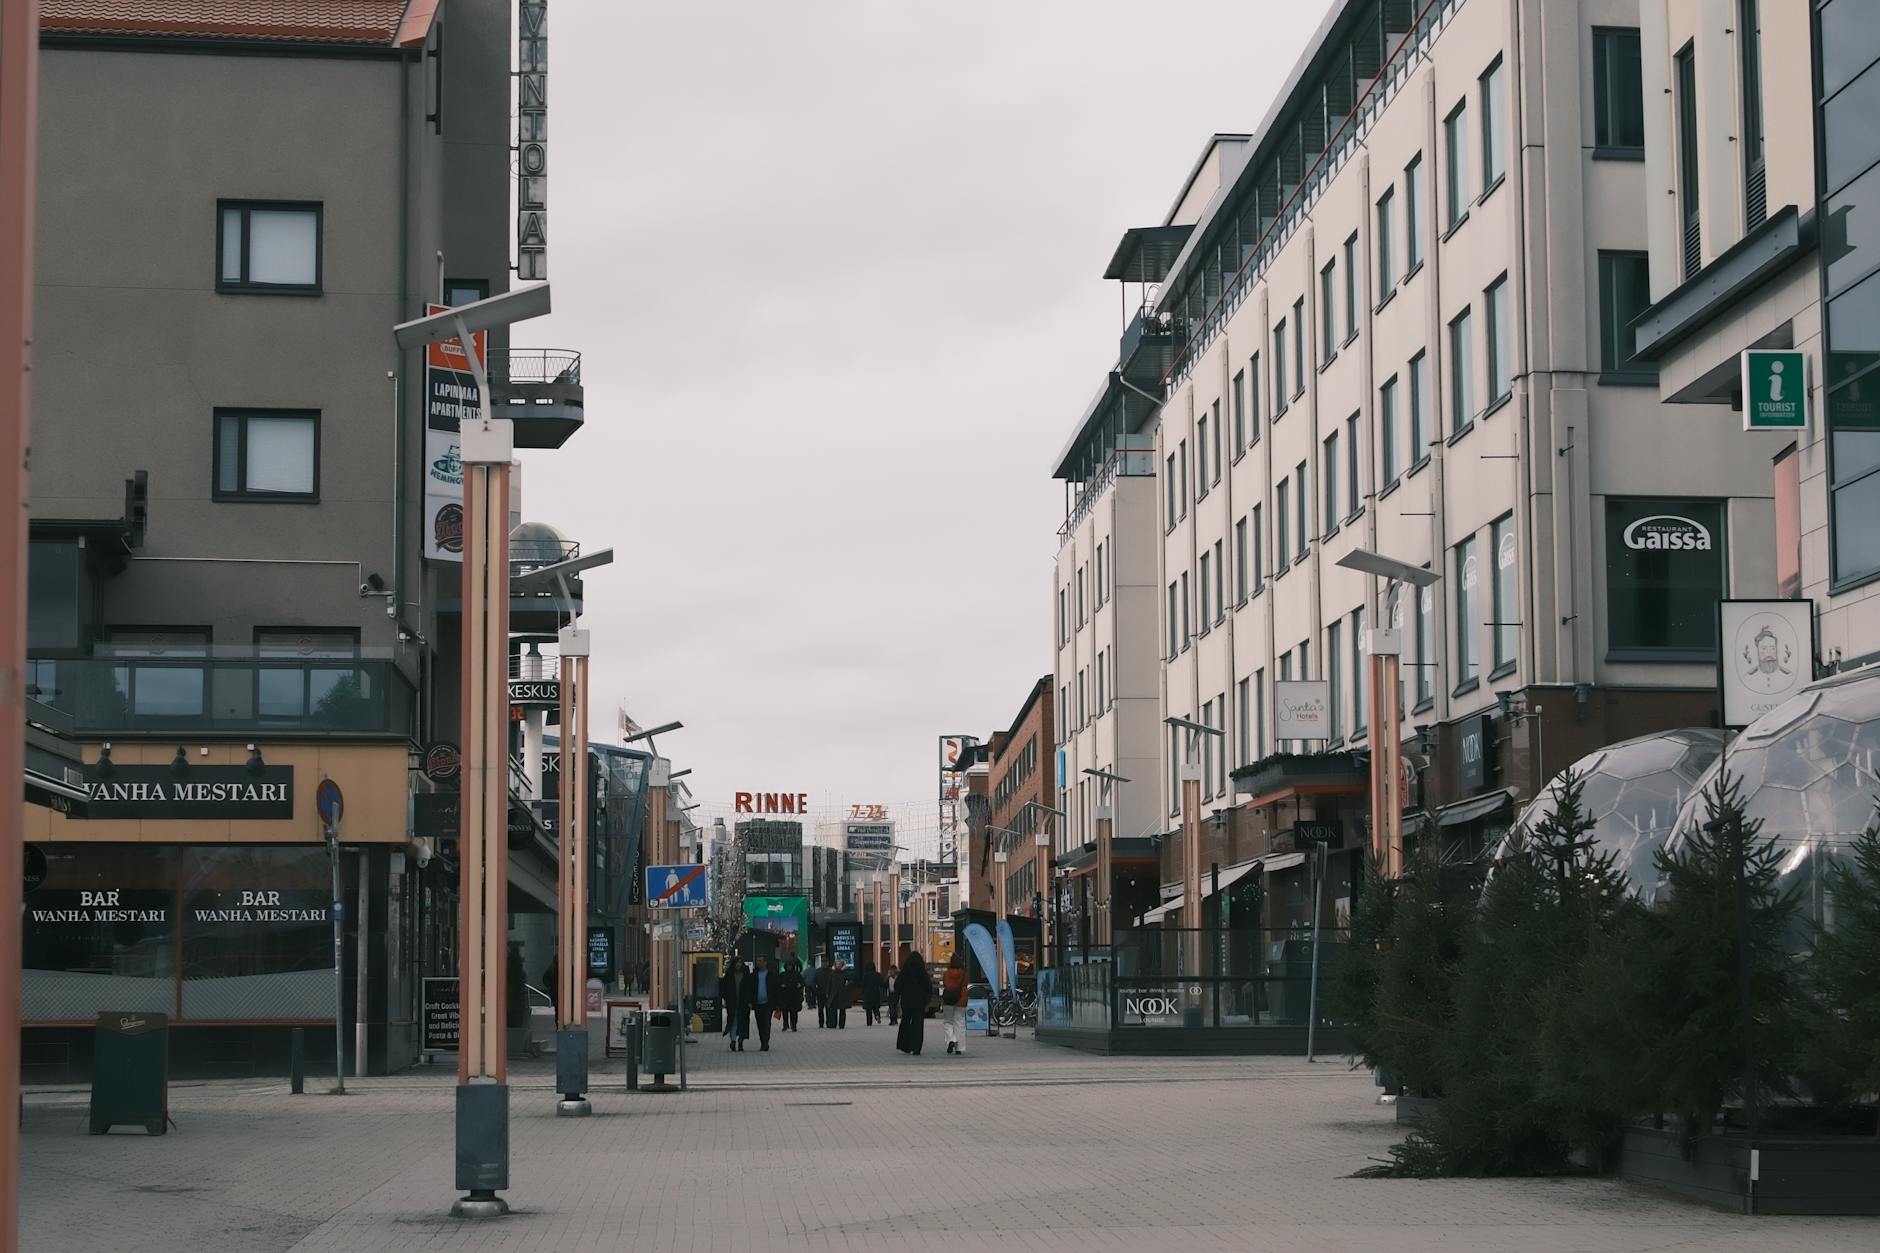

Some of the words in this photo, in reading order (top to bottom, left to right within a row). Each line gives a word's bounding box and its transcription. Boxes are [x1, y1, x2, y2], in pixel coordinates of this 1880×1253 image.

[522, 0, 546, 278] VINTOLAT
[434, 382, 478, 402] LAPINMAA
[430, 401, 482, 419] APARTMENTS
[1757, 402, 1796, 412] TOURIST
[1623, 517, 1712, 550] Gaissa
[172, 783, 288, 801] MESTARI
[735, 791, 808, 814] RINNE
[1299, 825, 1338, 839] NOOK
[80, 891, 120, 907] BAR
[241, 890, 280, 906] BAR
[32, 910, 91, 922] WANHA
[93, 909, 166, 922] MESTARI
[195, 909, 252, 922] WANHA
[255, 909, 328, 921] MESTARI
[425, 1002, 441, 1010] Craft
[1125, 997, 1178, 1015] NOOK
[431, 1012, 448, 1020] Great
[428, 1021, 440, 1030] and
